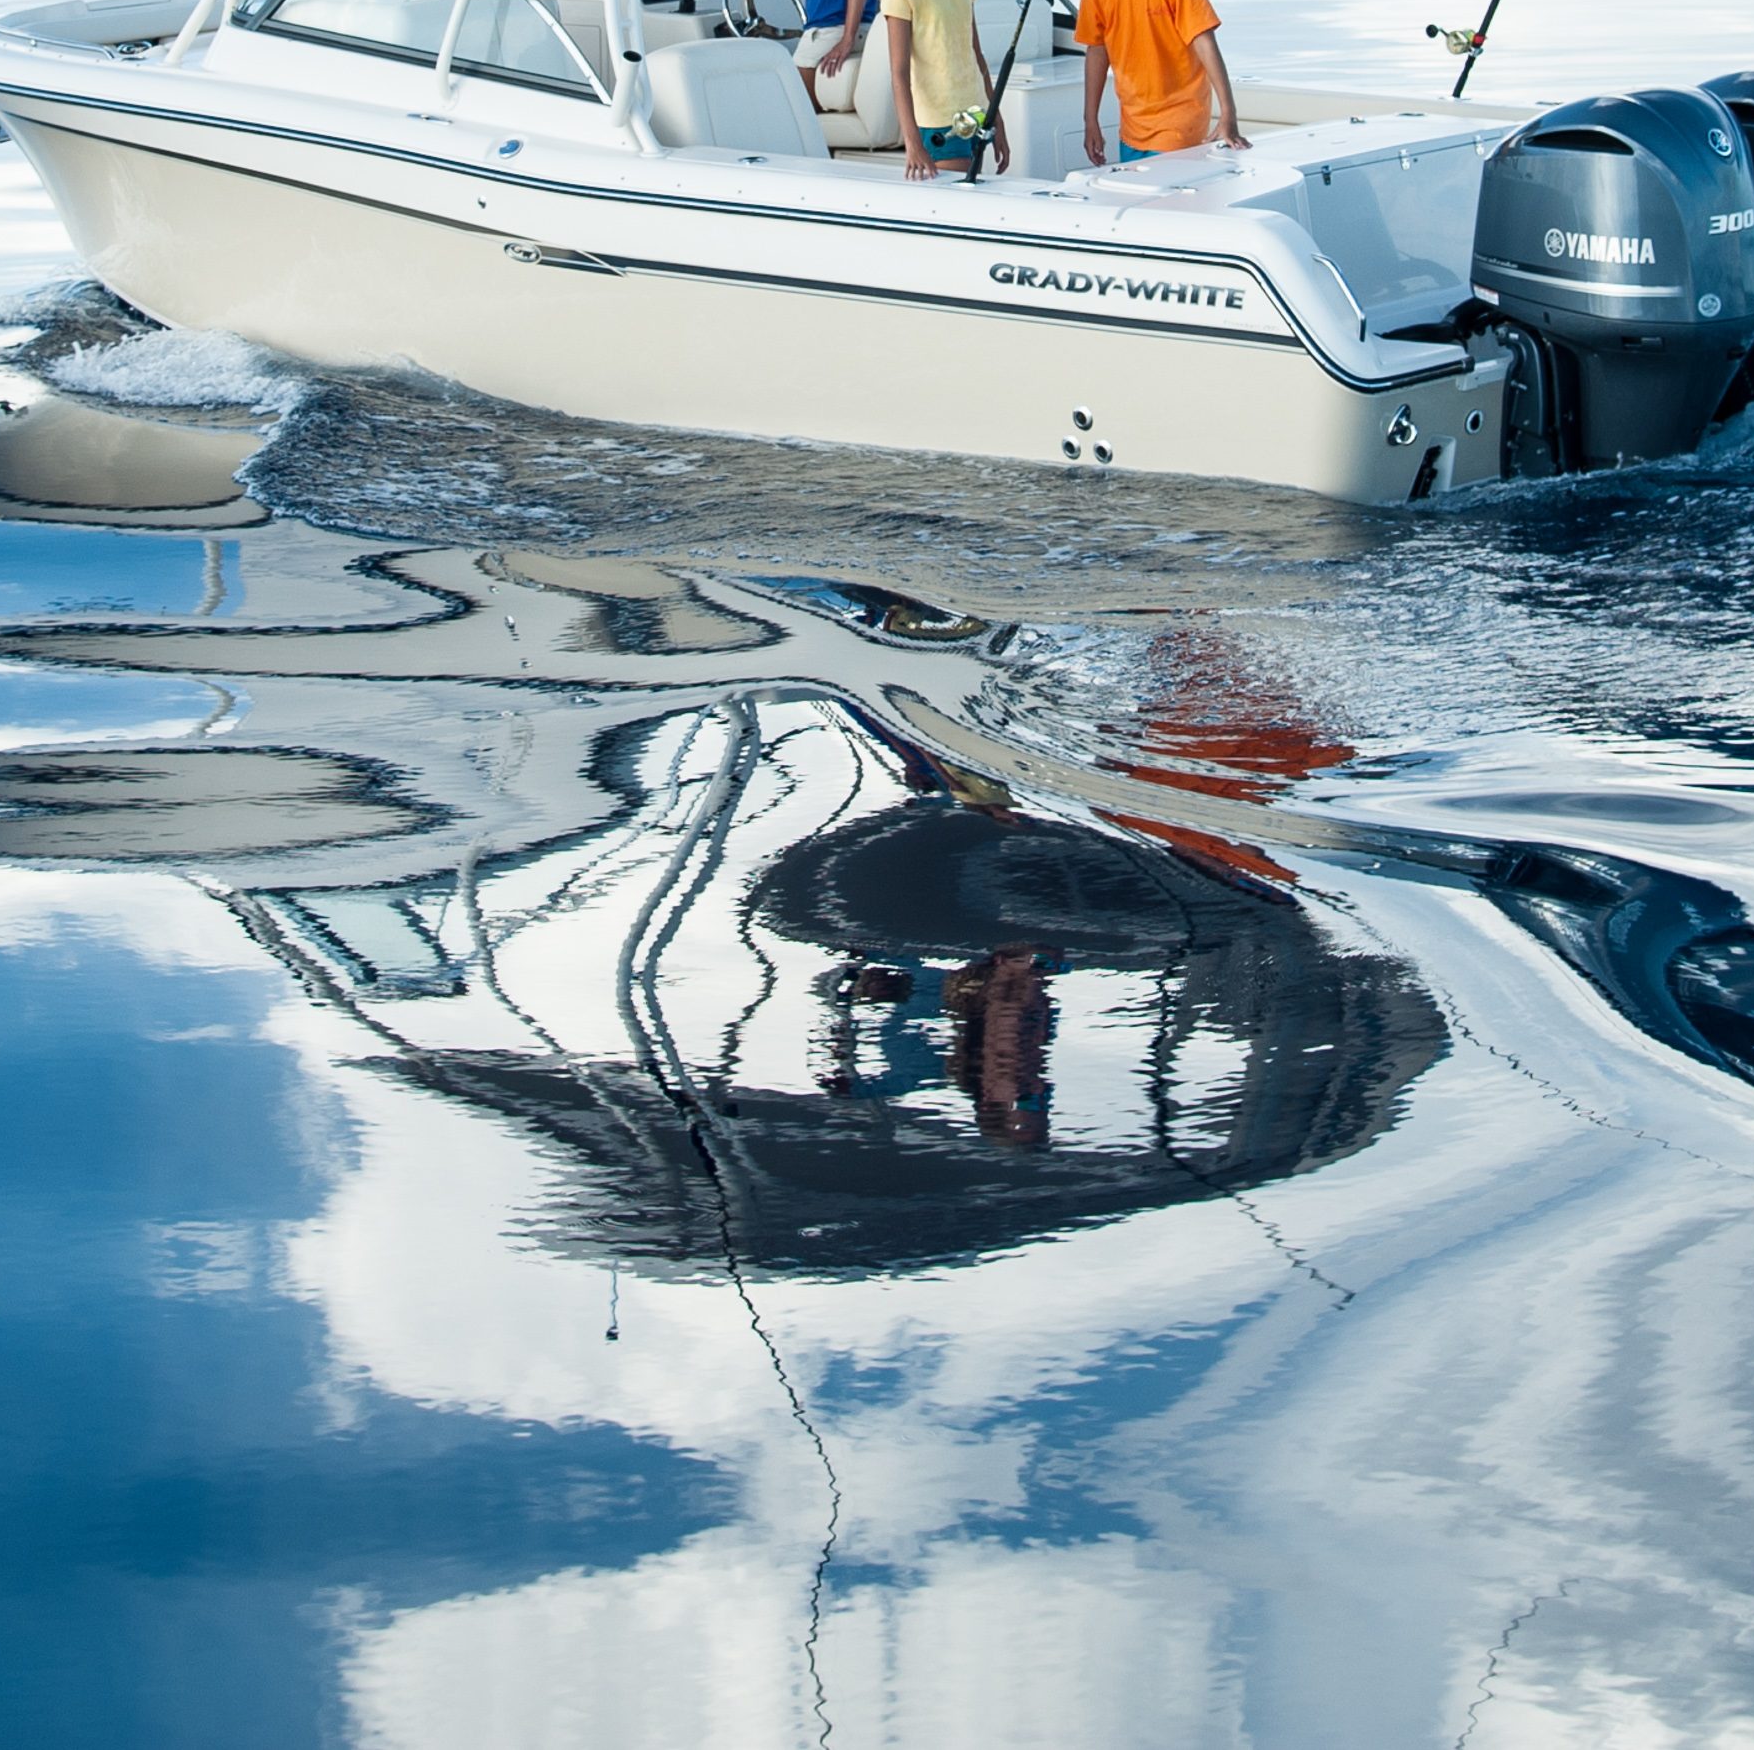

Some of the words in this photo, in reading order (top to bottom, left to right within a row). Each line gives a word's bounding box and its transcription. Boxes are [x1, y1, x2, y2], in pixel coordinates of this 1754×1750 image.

[1708, 209, 1754, 235] 300
[1566, 232, 1656, 264] YAMAHA
[989, 262, 1246, 310] GRADY-WHITE
